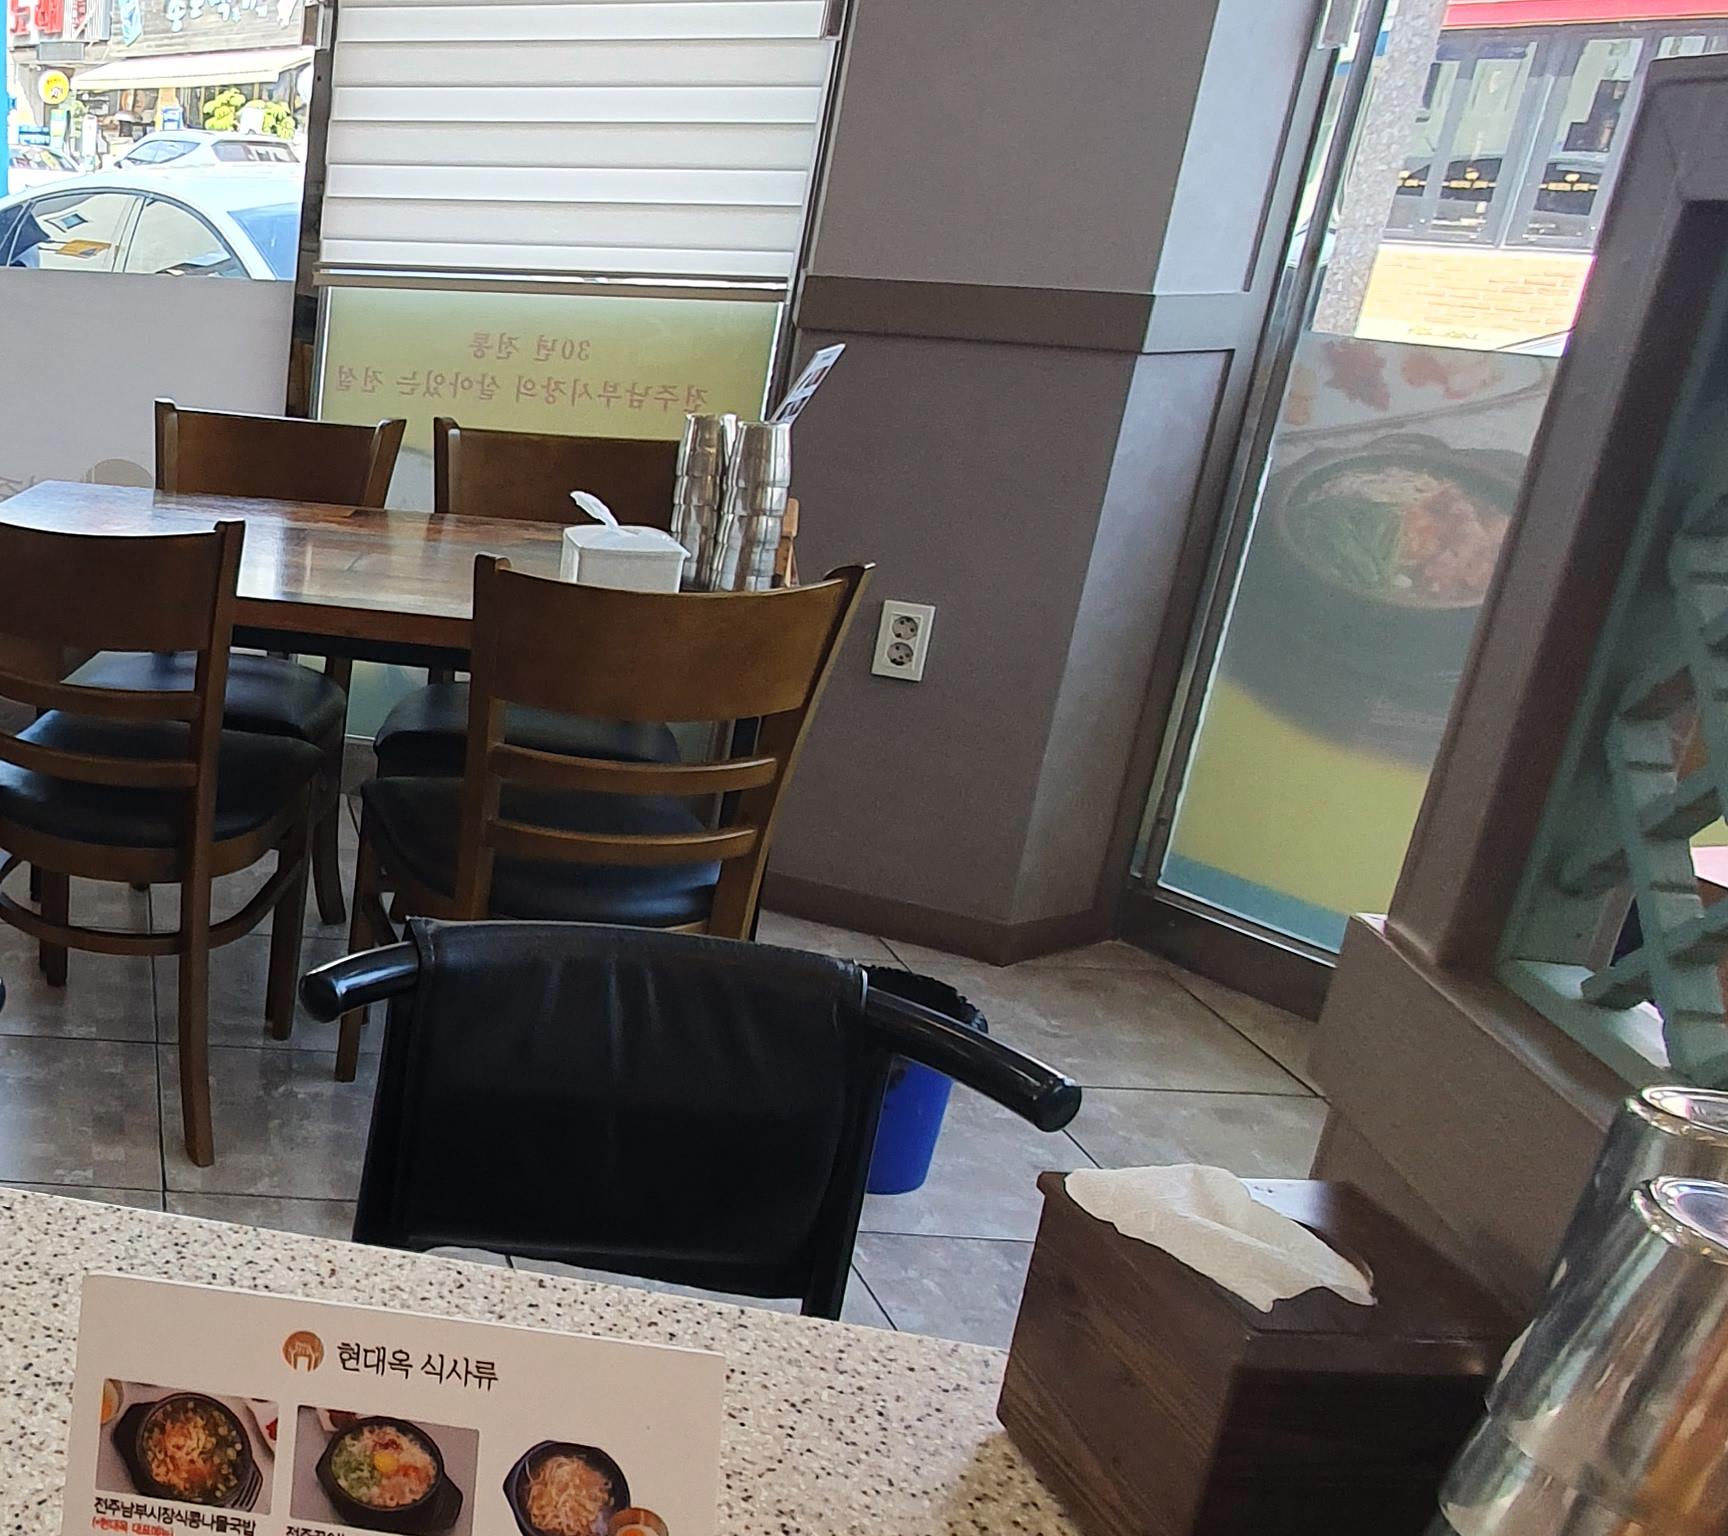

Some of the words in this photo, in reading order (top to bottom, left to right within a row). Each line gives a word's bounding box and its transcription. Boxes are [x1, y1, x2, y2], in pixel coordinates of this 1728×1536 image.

[336, 1341, 414, 1380] 현대옥
[419, 1353, 500, 1392] 식사류
[94, 1496, 257, 1536] 전주남부시장식콩나물국밥
